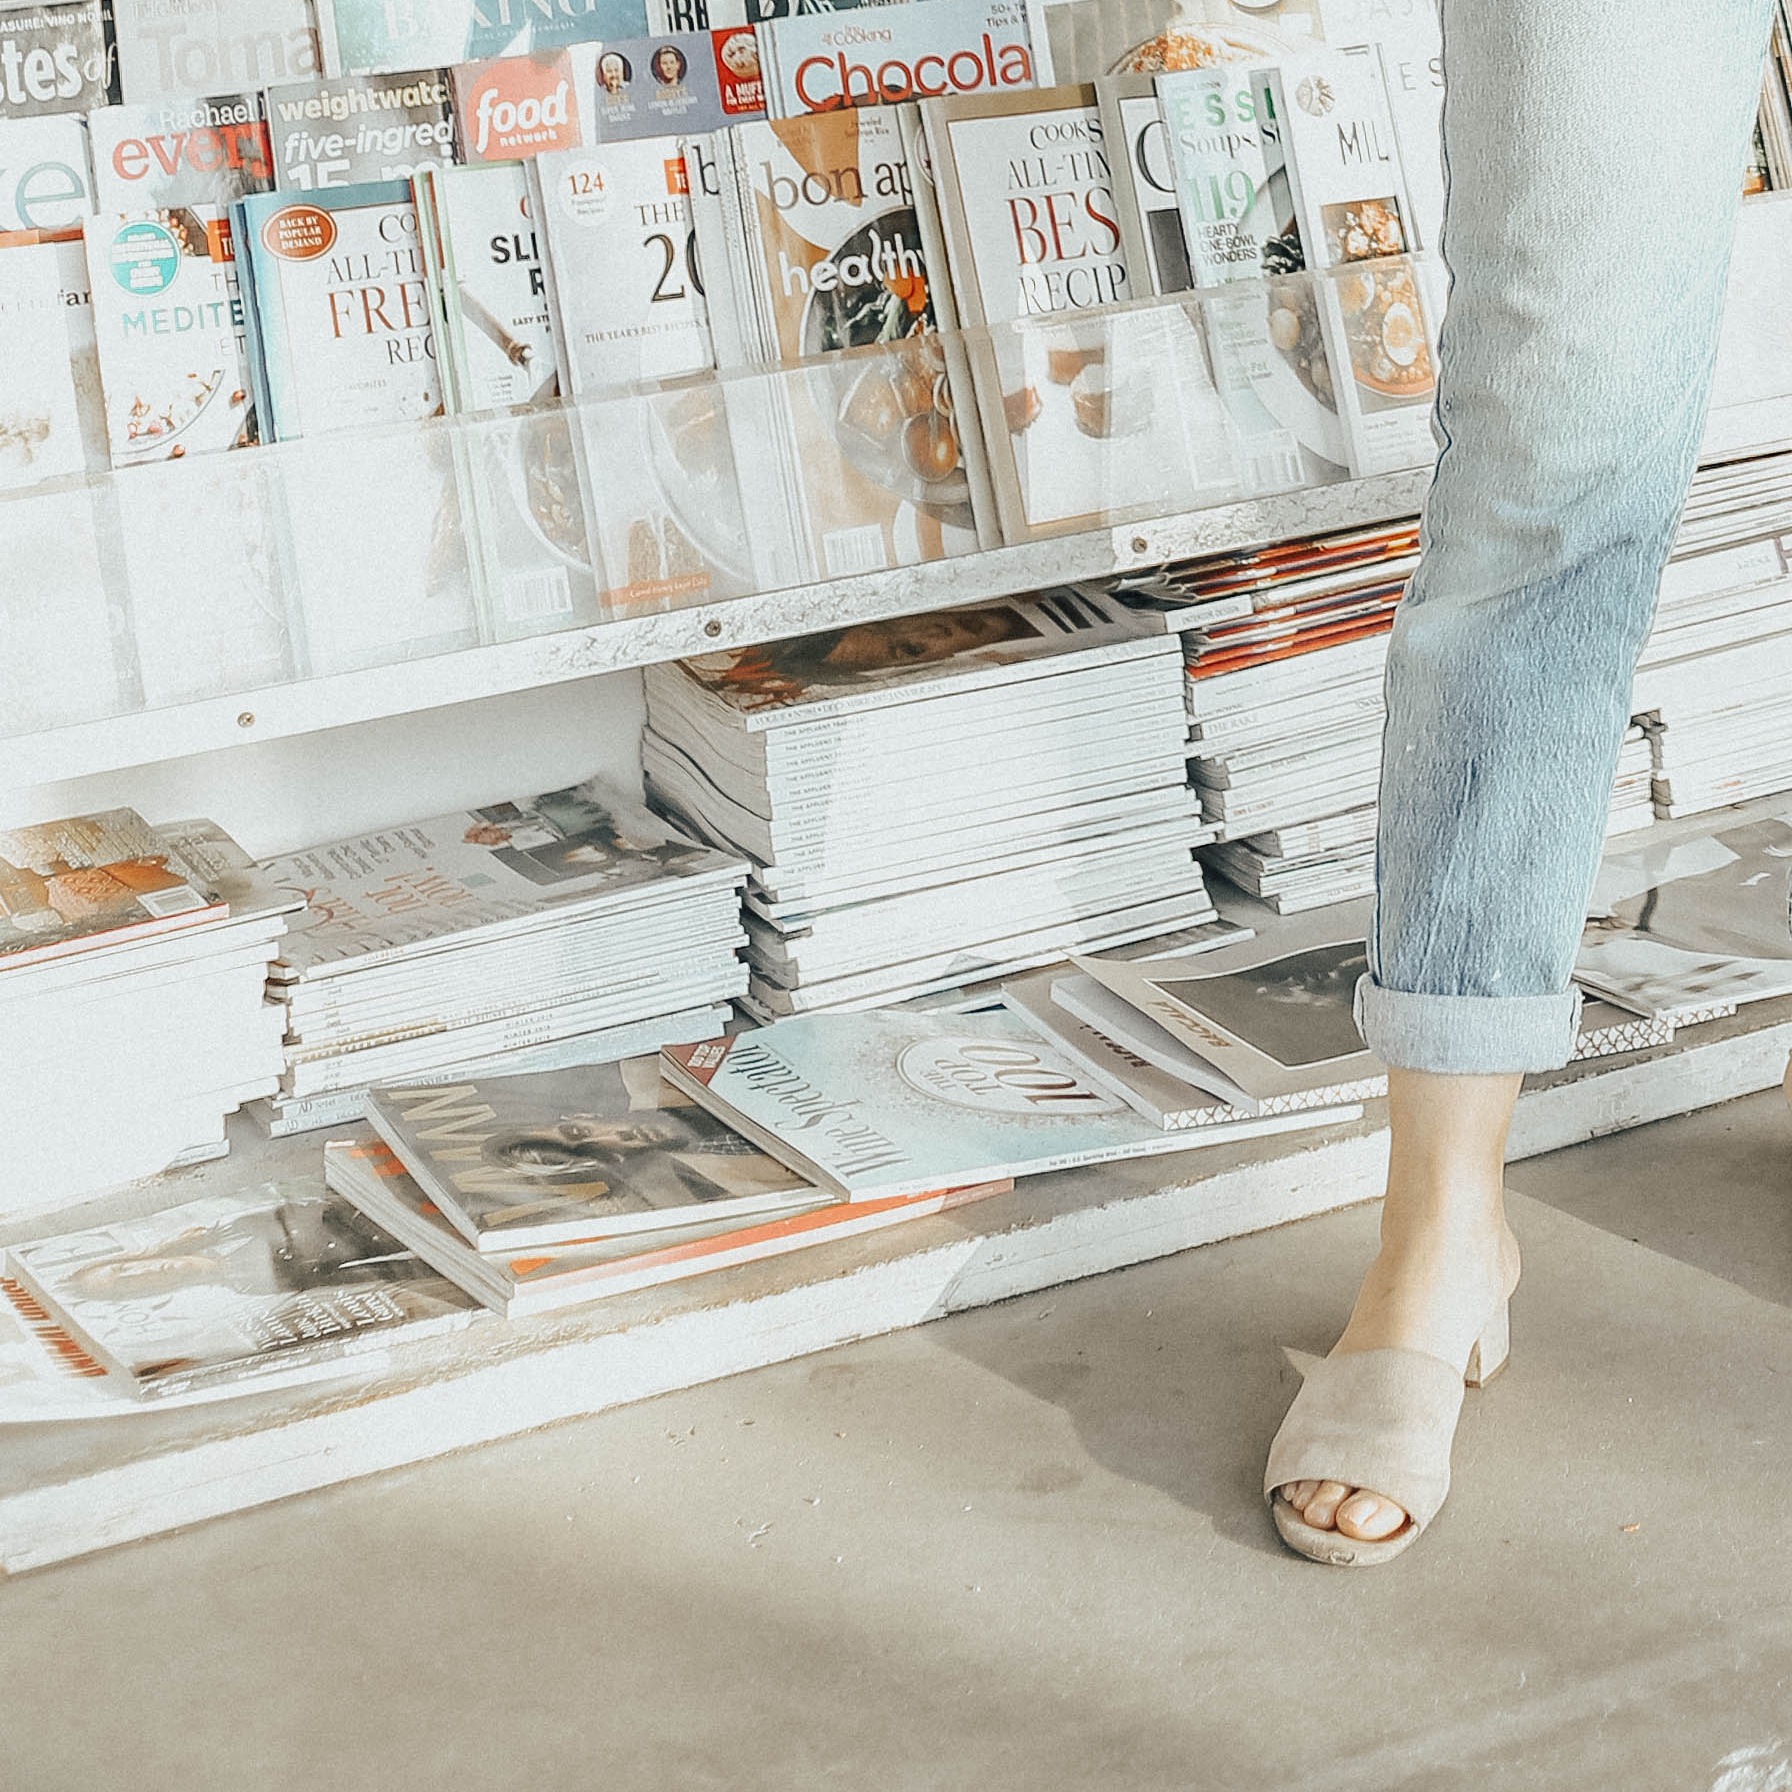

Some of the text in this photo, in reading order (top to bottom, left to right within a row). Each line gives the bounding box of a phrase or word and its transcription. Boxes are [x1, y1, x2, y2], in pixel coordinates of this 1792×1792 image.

[797, 34, 1031, 111] Chocola
[160, 101, 252, 128] Rachael
[476, 81, 568, 153] food
[500, 130, 557, 147] network
[1031, 118, 1103, 149] COOK'S
[569, 172, 605, 195] 124
[760, 161, 868, 210] bon
[1186, 170, 1255, 220] 119
[280, 226, 322, 238] POPULAR
[281, 237, 322, 249] DEMAND
[1204, 250, 1257, 265] WONDERS
[728, 1044, 909, 1177] Wine Spectator
